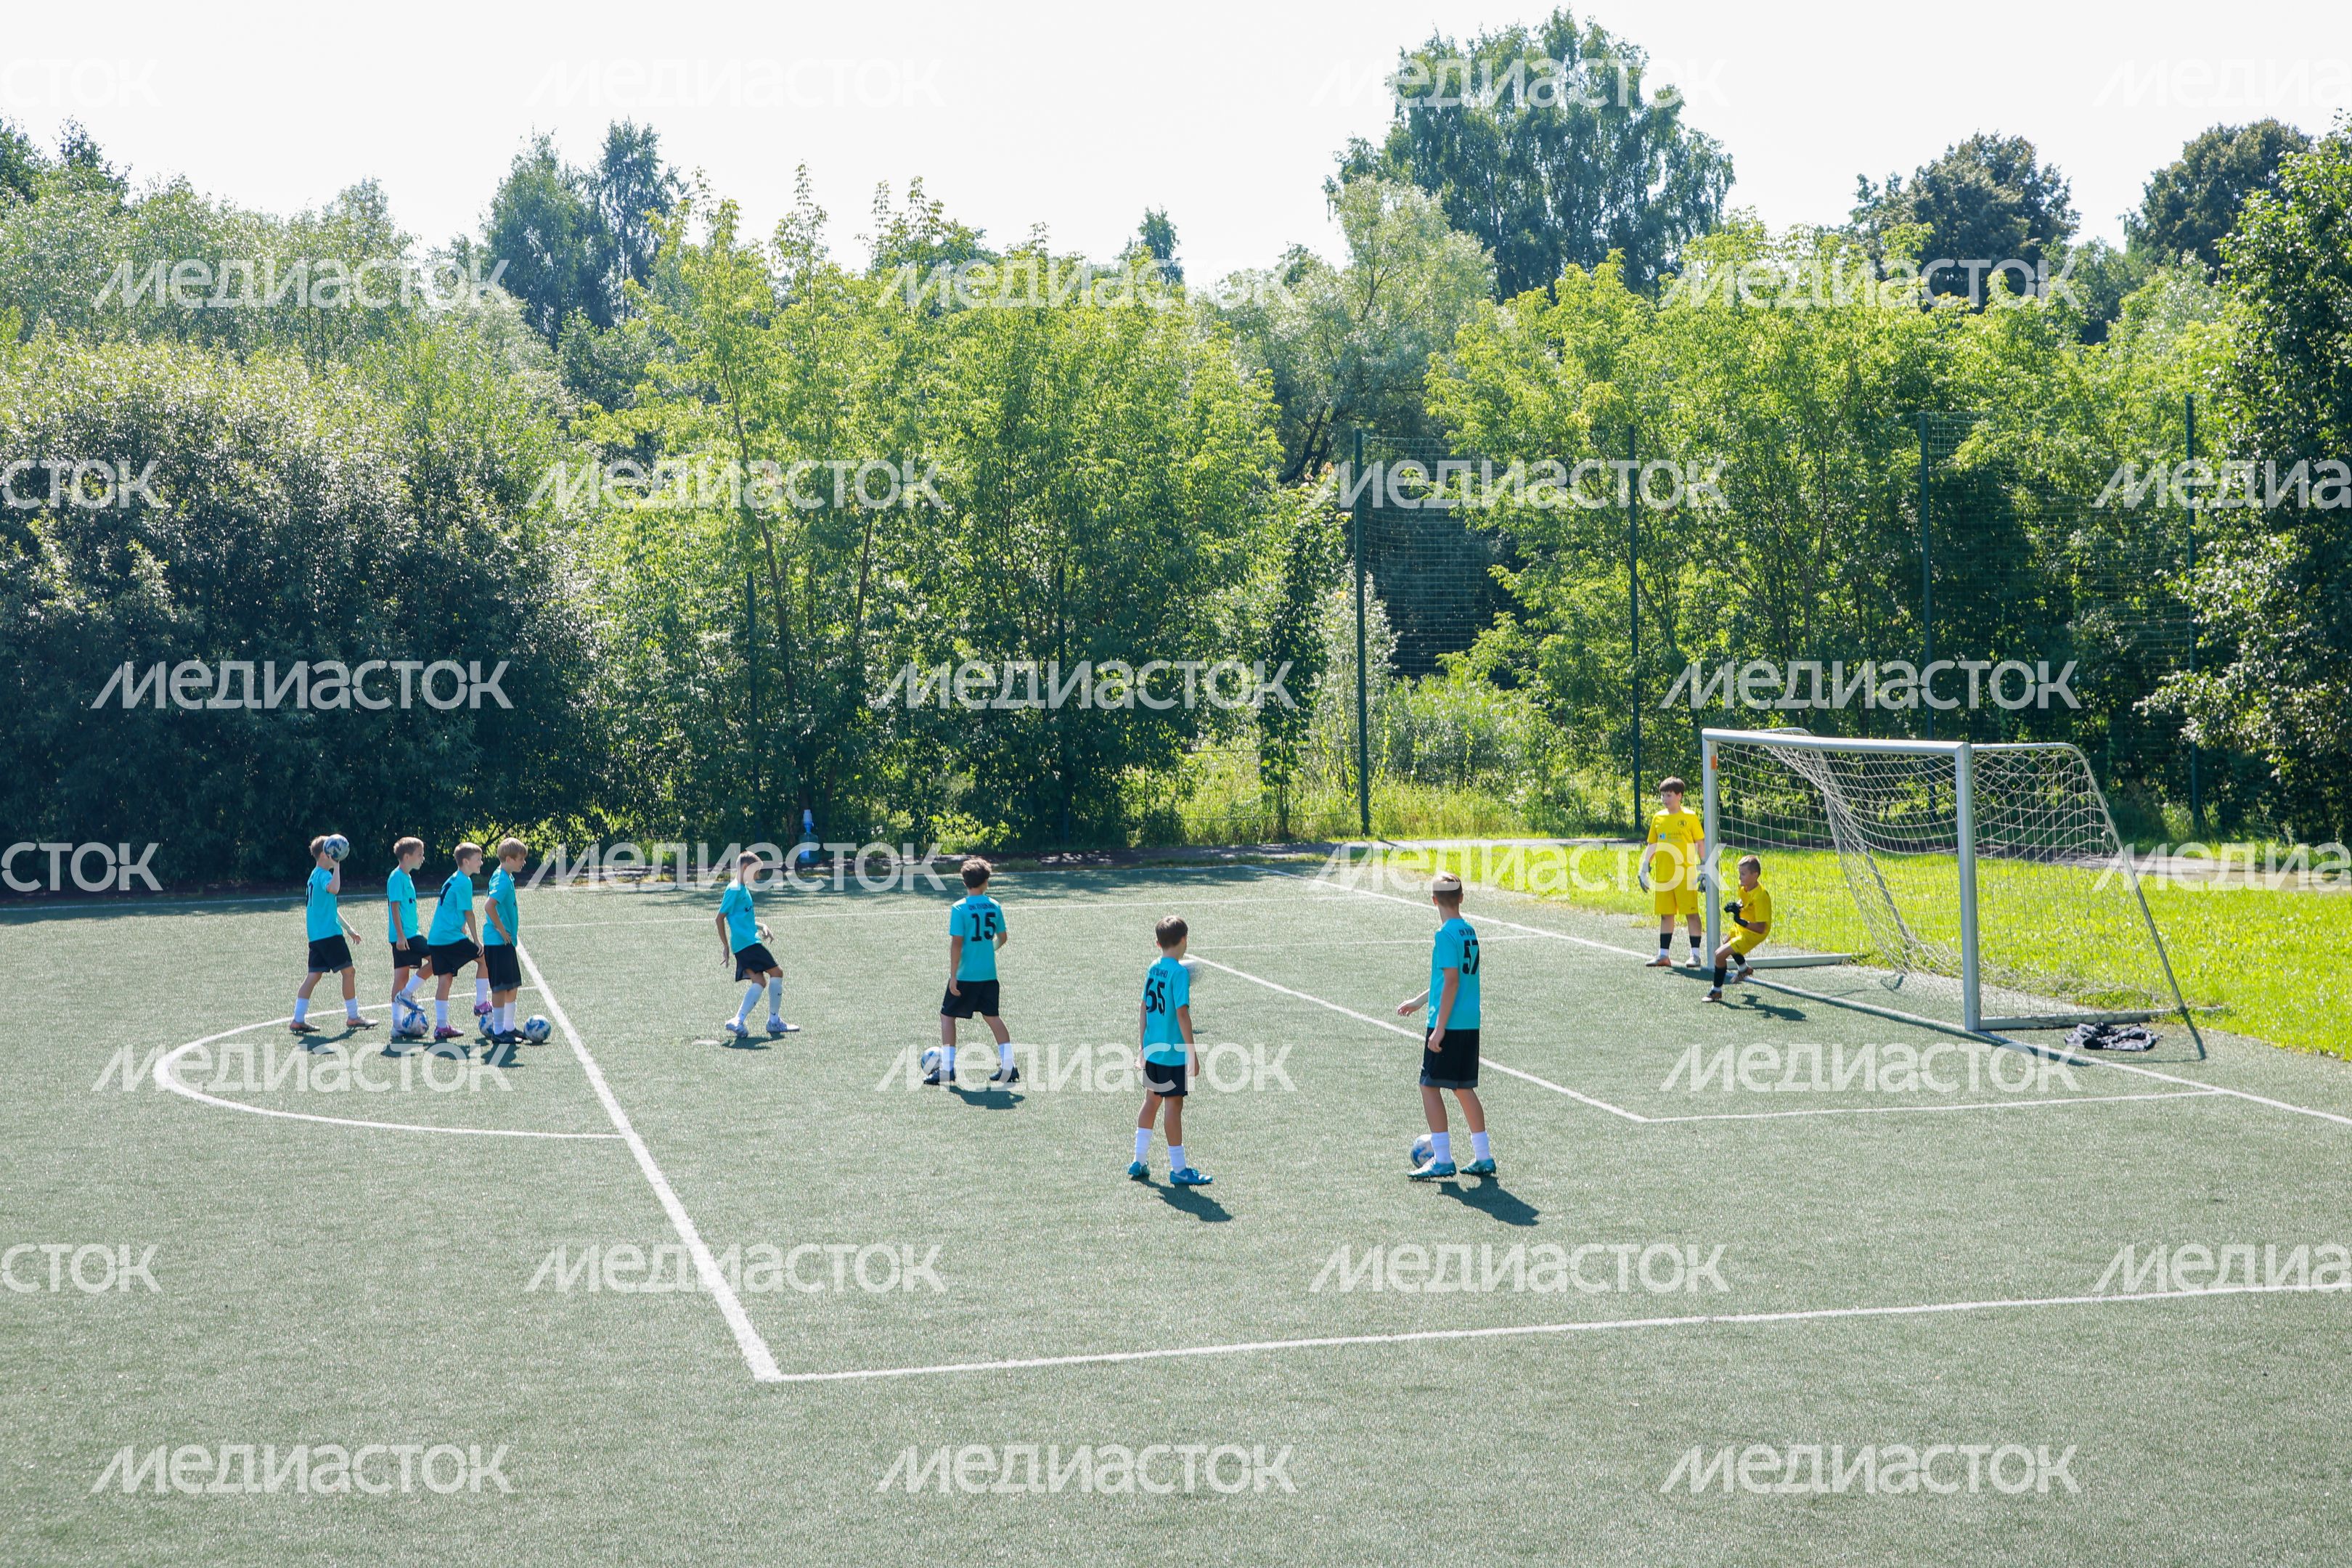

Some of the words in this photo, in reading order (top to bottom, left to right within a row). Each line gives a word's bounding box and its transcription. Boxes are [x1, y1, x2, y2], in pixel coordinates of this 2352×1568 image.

[971, 912, 997, 942] 15
[1462, 939, 1480, 975] 57
[1146, 978, 1166, 1016] 65
